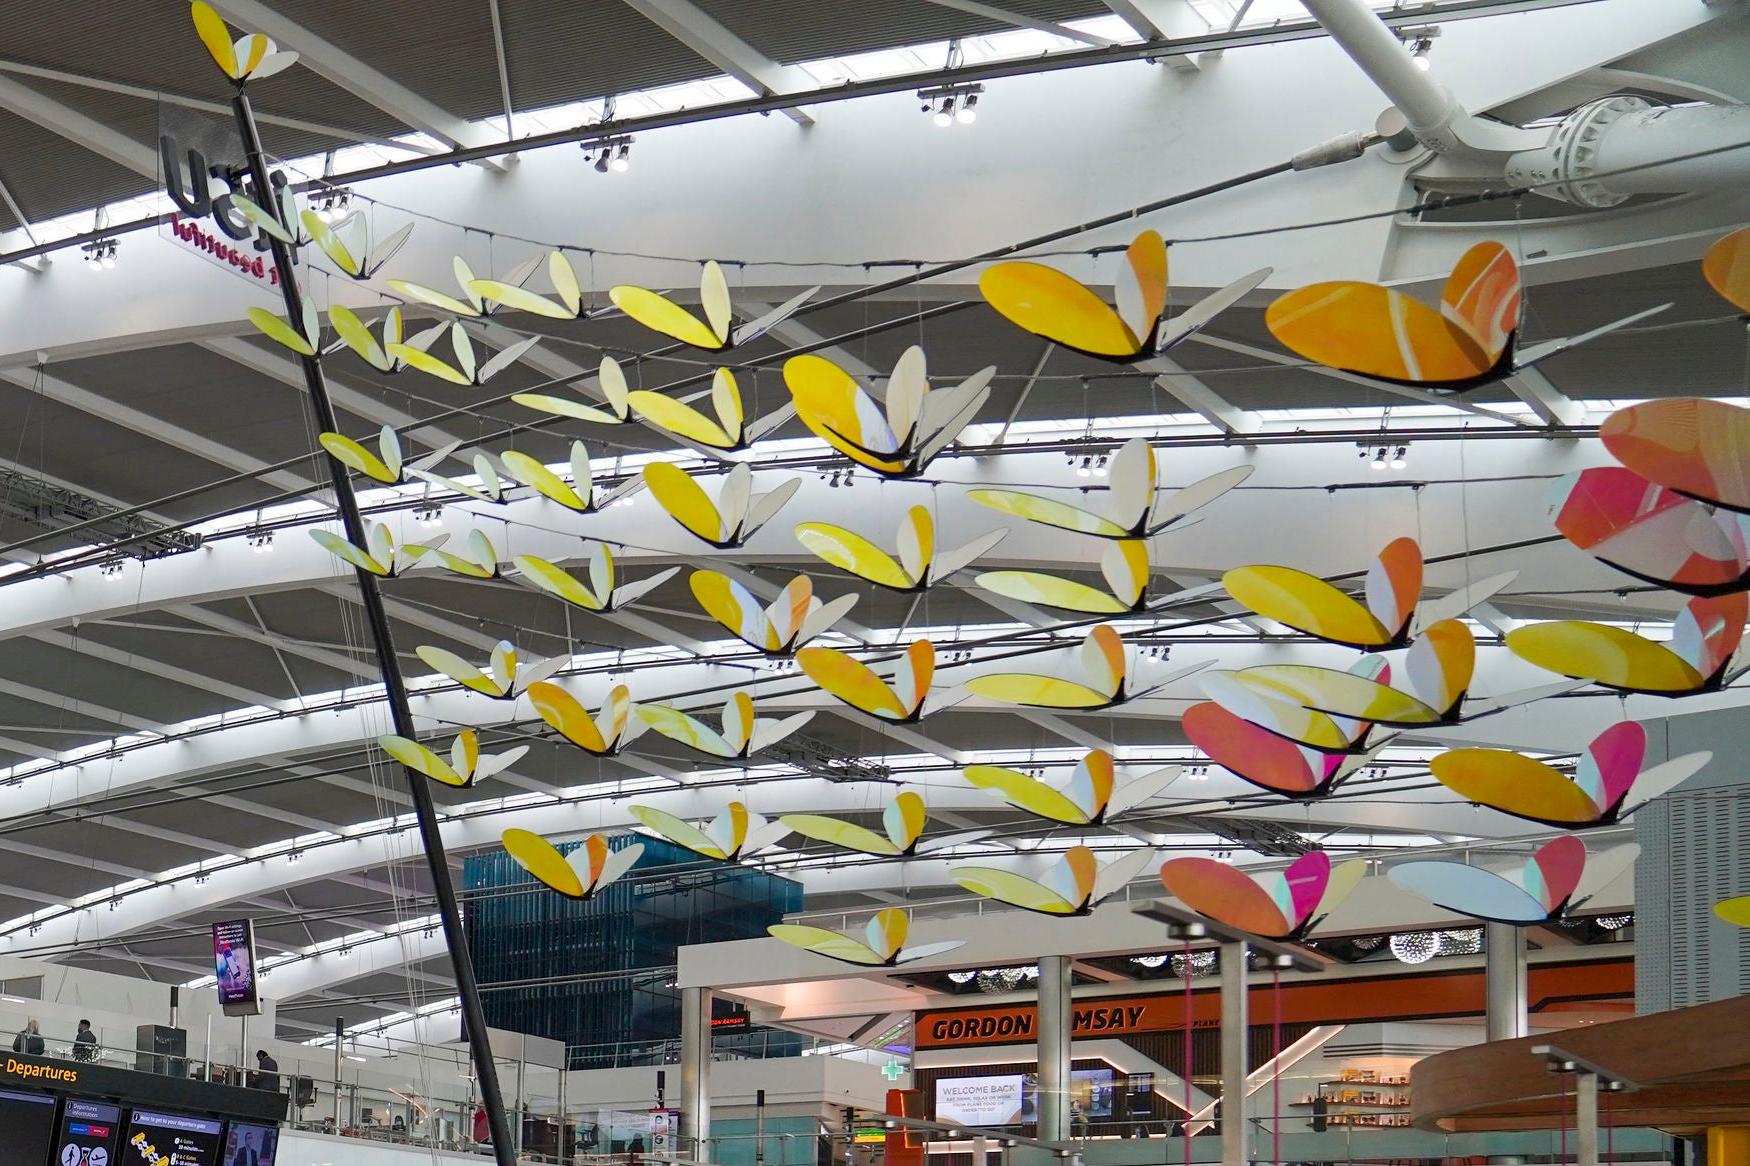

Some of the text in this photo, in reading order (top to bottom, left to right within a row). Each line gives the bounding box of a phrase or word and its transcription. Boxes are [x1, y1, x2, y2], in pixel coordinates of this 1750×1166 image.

[932, 1006, 1146, 1041] GORDON MSAY
[7, 1058, 78, 1082] Departures
[943, 1085, 1016, 1095] WELCOME BACK
[73, 1103, 98, 1112] Departures
